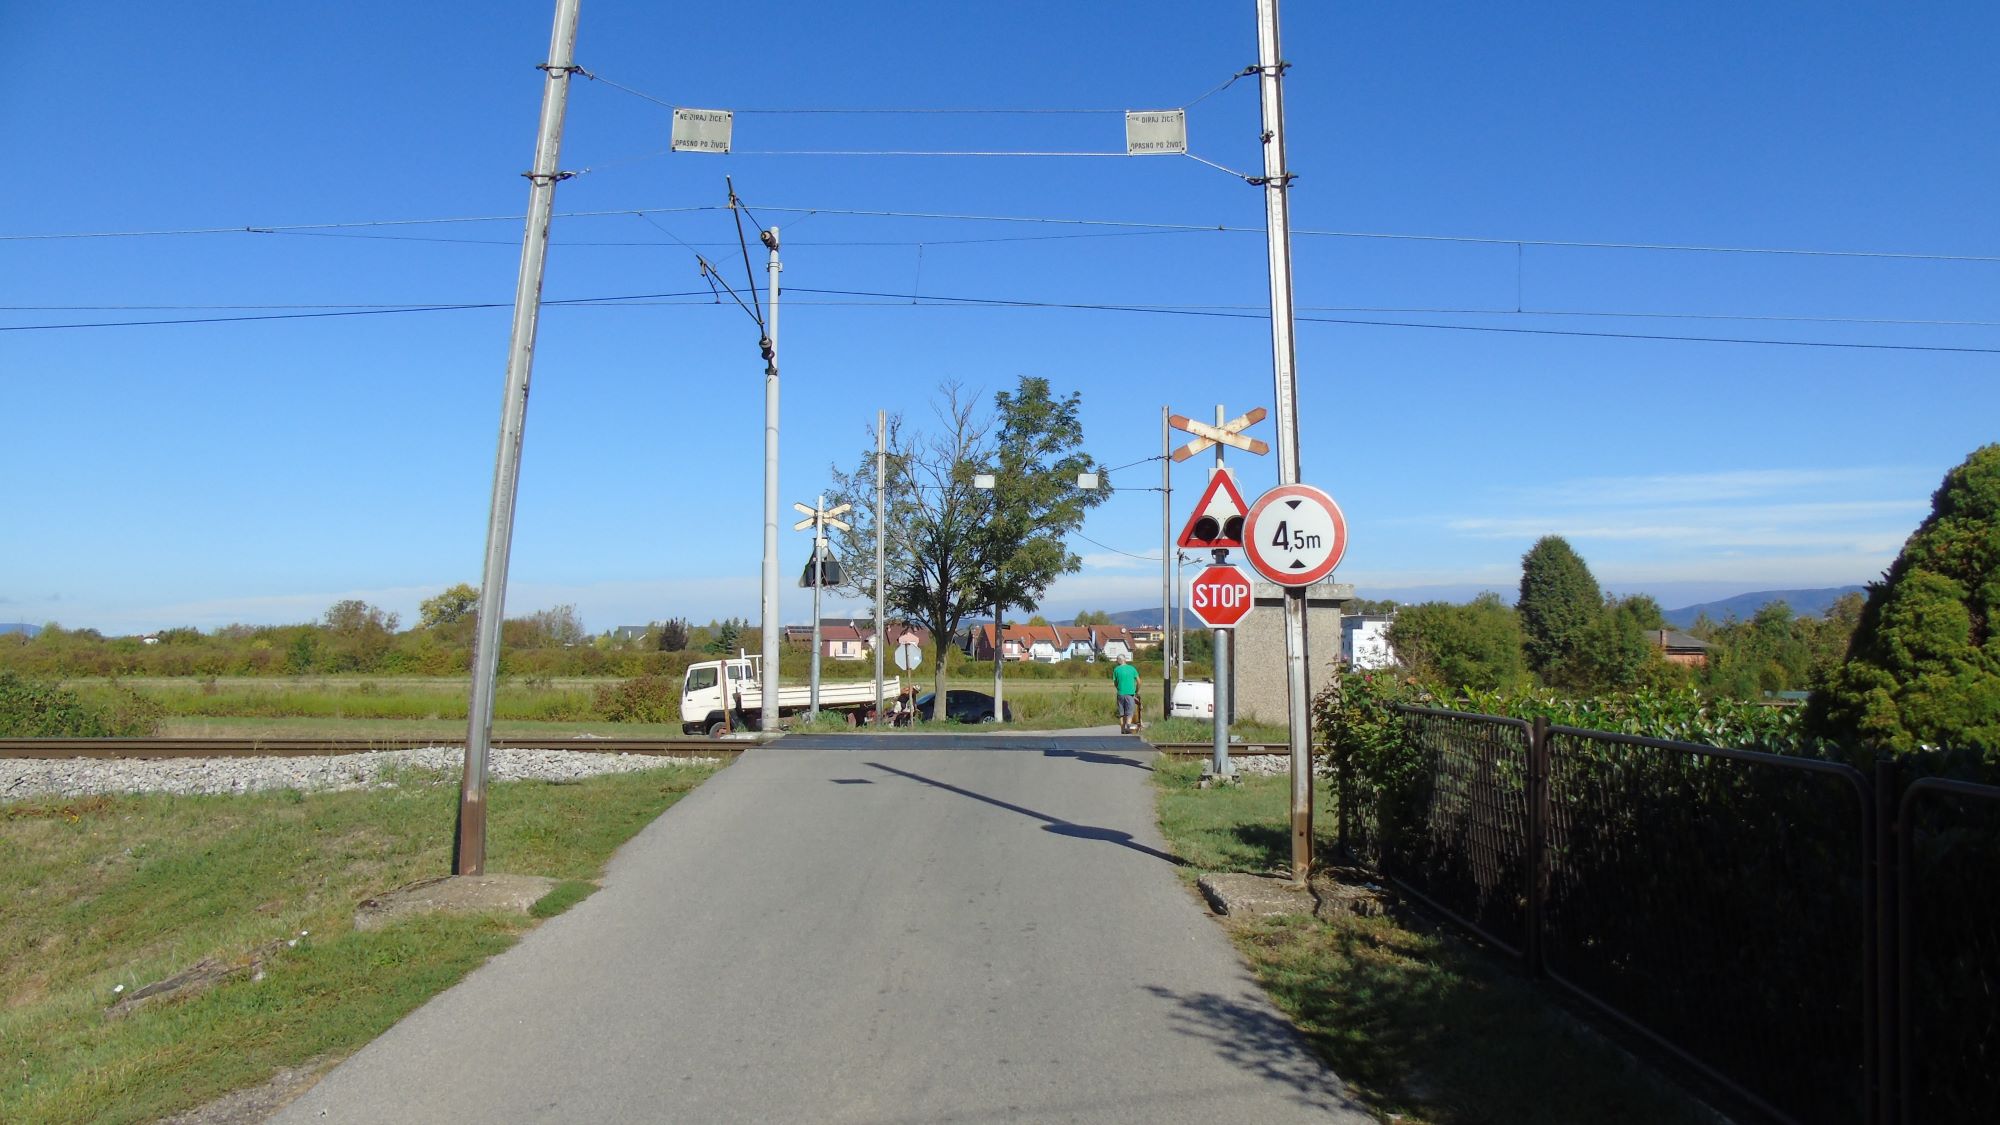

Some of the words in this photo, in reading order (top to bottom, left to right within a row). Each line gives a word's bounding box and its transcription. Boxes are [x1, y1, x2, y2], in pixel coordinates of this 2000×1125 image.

[675, 139, 698, 147] OPASNO
[1272, 520, 1321, 553] 4,5m
[1195, 584, 1248, 608] STOP
